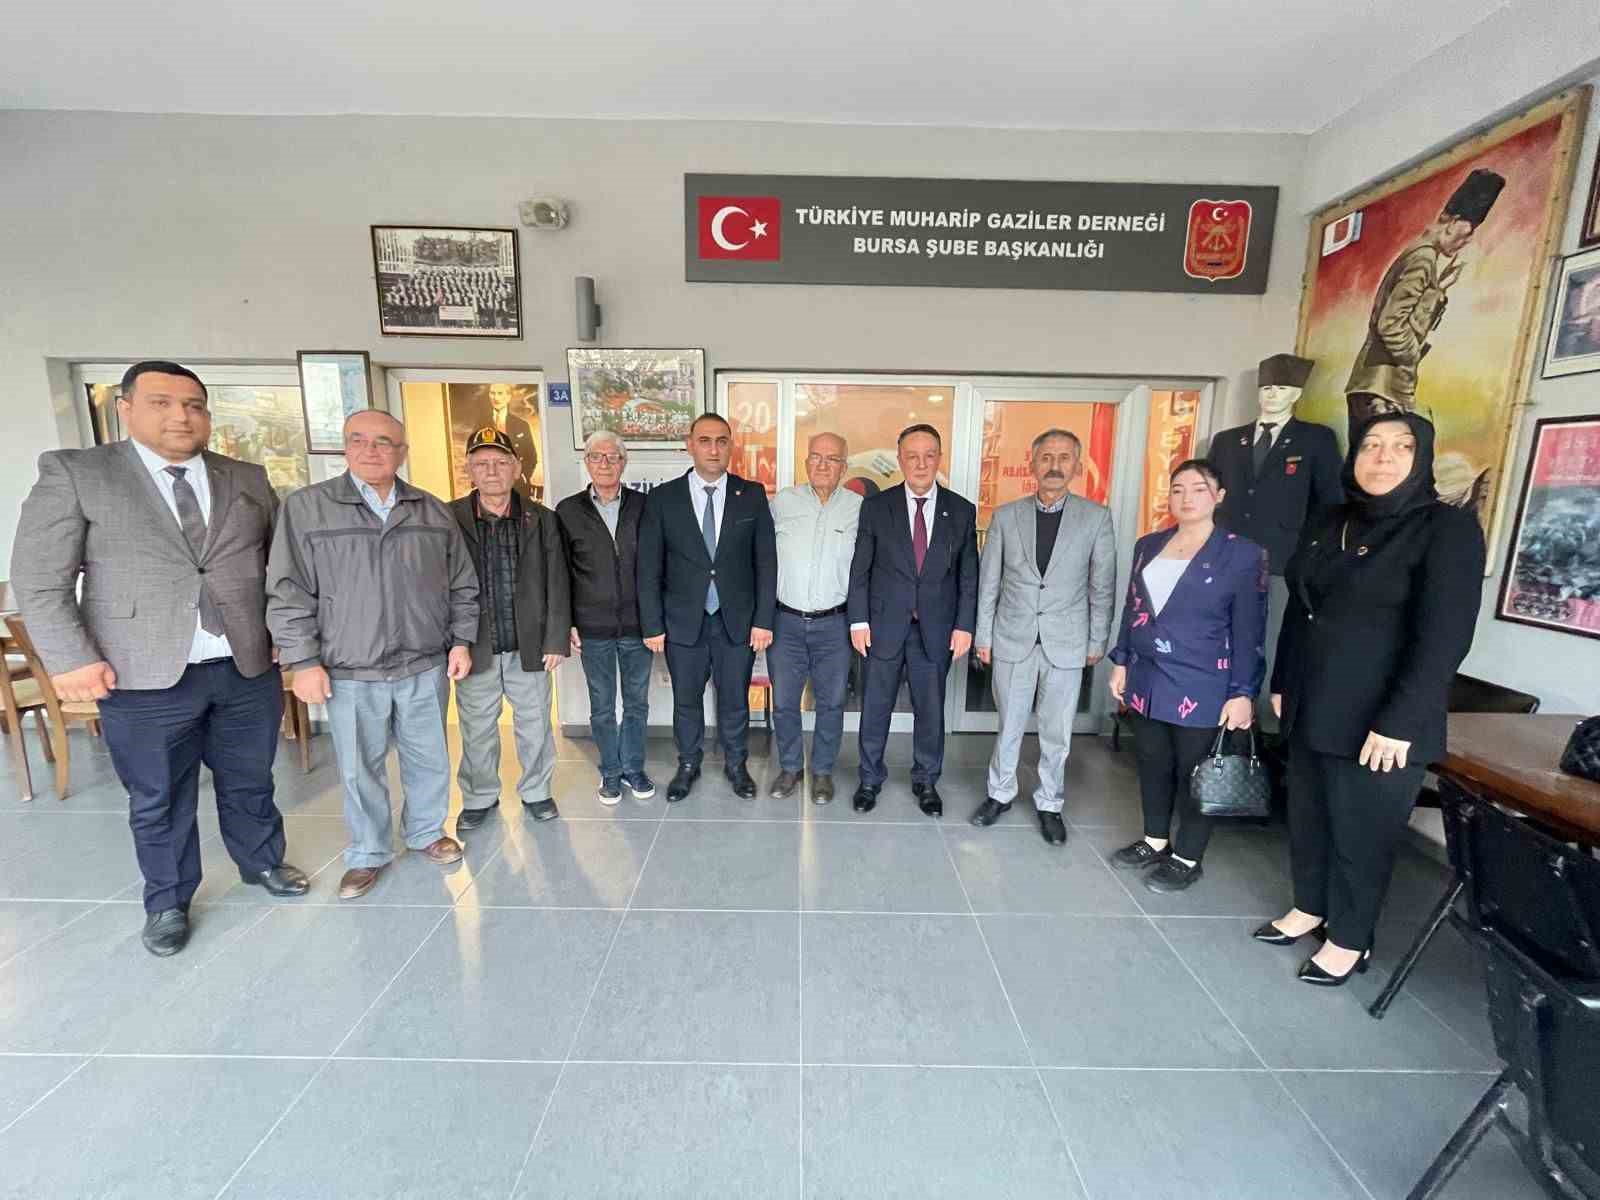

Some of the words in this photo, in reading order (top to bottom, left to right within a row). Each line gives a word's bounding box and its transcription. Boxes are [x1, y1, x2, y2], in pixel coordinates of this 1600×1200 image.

[795, 205, 884, 226] TÜRKİYE
[889, 208, 982, 228] MUHARİP
[987, 209, 1072, 231] GAZİLER
[1077, 212, 1166, 232] DERNEĞİ
[853, 237, 921, 255] BURSA
[925, 238, 979, 259] ŞUBE
[984, 239, 1105, 261] BAŞKANLIĞI
[553, 390, 569, 401] 3A
[736, 399, 771, 433] 20
